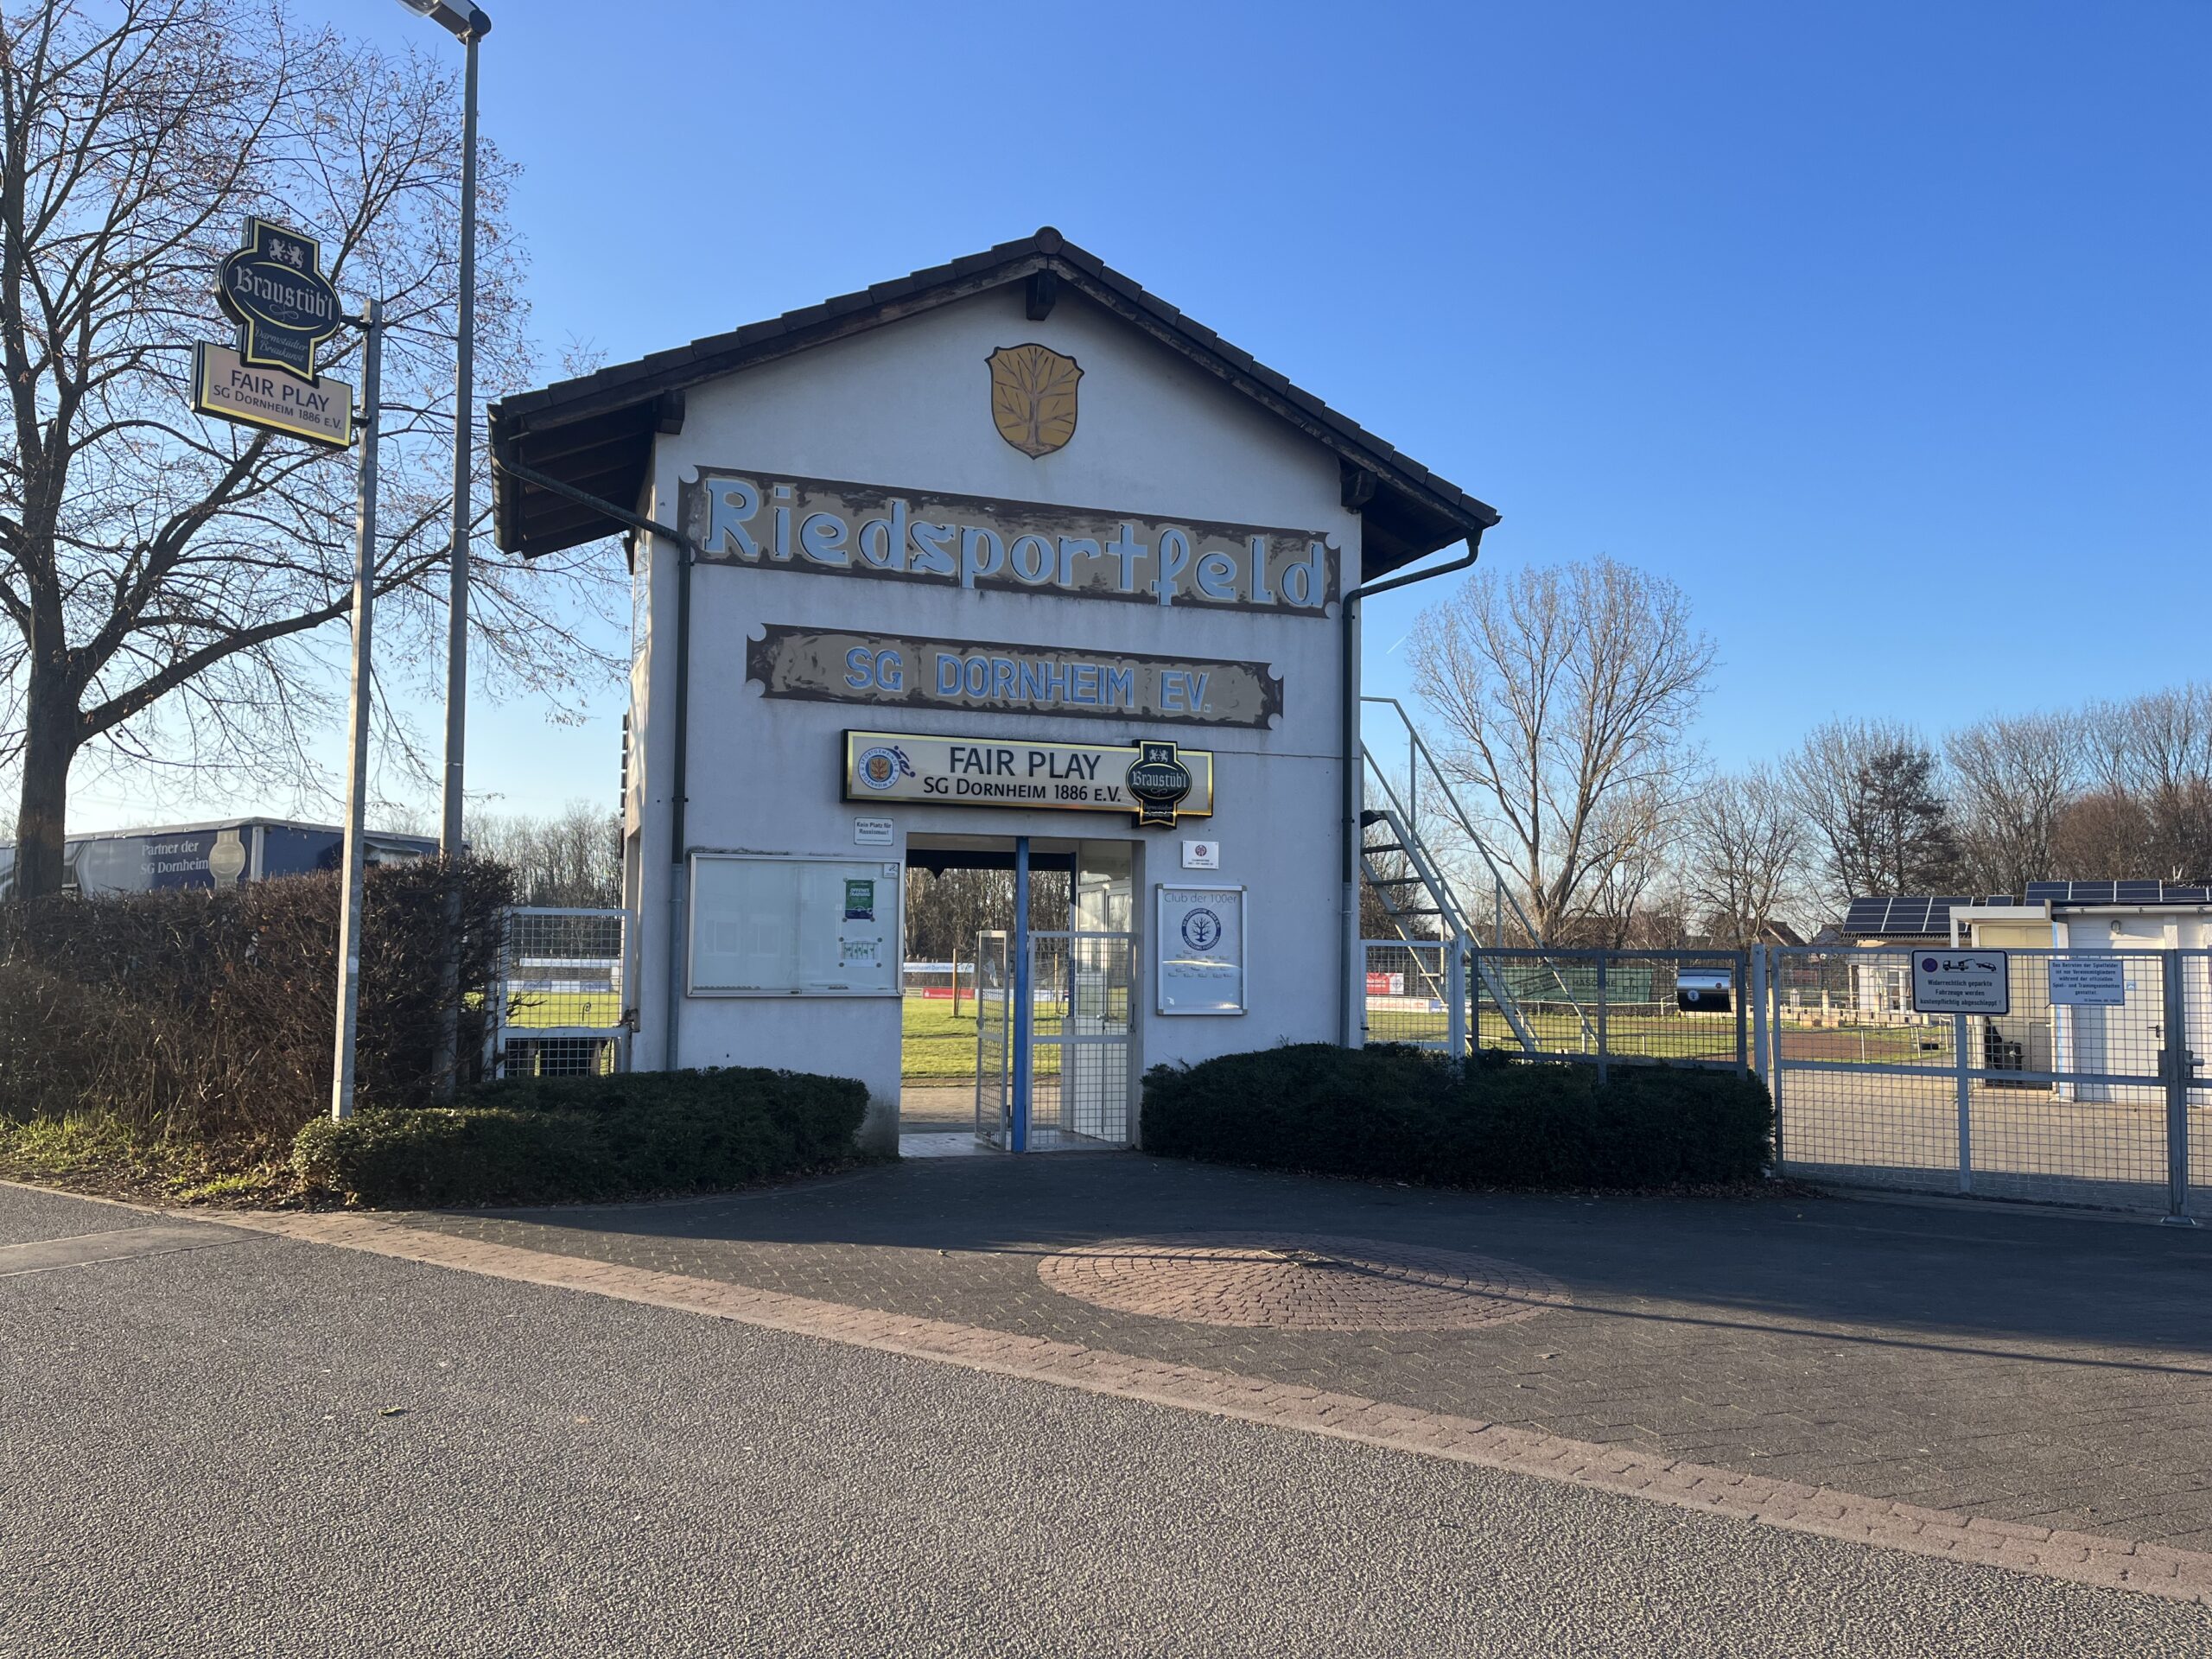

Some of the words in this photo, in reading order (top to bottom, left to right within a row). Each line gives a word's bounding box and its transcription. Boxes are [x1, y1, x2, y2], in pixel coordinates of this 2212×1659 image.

[231, 369, 274, 398] FAIR
[282, 384, 330, 413] PLAY
[213, 385, 231, 399] SG
[299, 409, 321, 424] 1886
[702, 477, 1325, 608] Riedsportfeld
[843, 646, 903, 691] SG
[936, 652, 1135, 709] DORNHEIM
[950, 746, 1014, 777] FAIR
[1028, 750, 1102, 781] PLAY
[923, 777, 949, 795] SG
[1054, 784, 1088, 801] 1886
[142, 843, 179, 856] Partner
[181, 840, 200, 853] der
[140, 861, 155, 874] SG
[157, 857, 208, 874] Dornheim
[1164, 893, 1188, 903] Club
[1190, 893, 1206, 903] der
[1211, 893, 1237, 903] 100er
[1920, 998, 1960, 1007] kostenpflichtig
[1961, 999, 1997, 1007] abgeschleppt
[1936, 988, 1963, 997] Fahrzeuge
